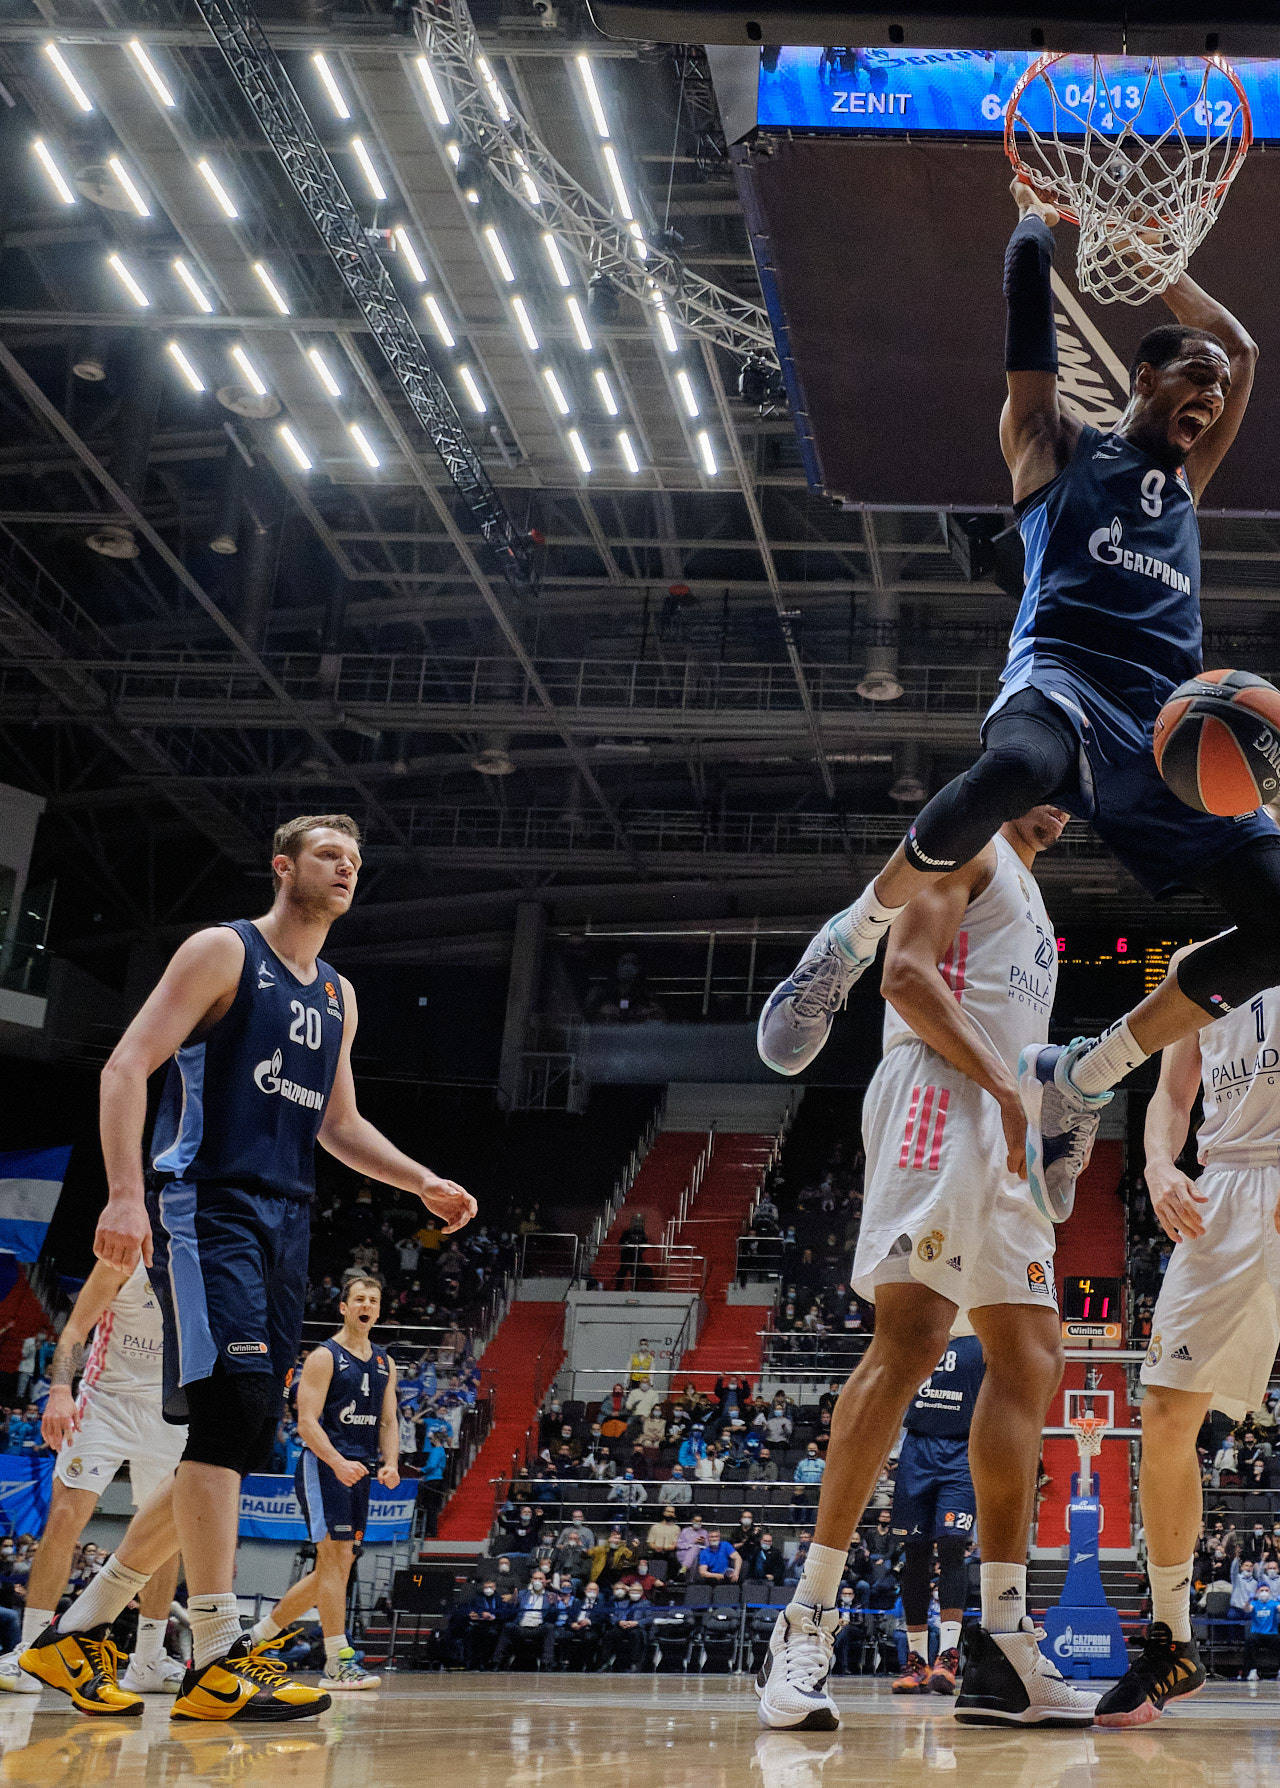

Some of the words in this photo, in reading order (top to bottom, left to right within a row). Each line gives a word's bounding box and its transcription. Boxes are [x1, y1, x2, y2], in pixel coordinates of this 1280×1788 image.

[830, 91, 913, 115] ZENIT
[1065, 84, 1140, 109] 04:13
[1194, 100, 1232, 127] 62
[1101, 112, 1114, 130] 4
[1141, 469, 1166, 518] 9
[1122, 550, 1191, 597] GAZPROM
[911, 839, 957, 867] BLINDSAVE
[1117, 938, 1128, 953] 6
[1008, 989, 1044, 1015] HOTEL
[289, 1000, 322, 1050] 20
[1251, 995, 1265, 1043] 1
[1083, 1296, 1109, 1318] 11
[1070, 1326, 1103, 1335] Winline
[231, 1344, 260, 1353] Winline
[1171, 1353, 1193, 1361] adidas
[360, 1372, 370, 1397] 4
[929, 1389, 963, 1401] GAZPROM
[241, 1498, 296, 1515] НАШЕ
[368, 1504, 408, 1517] НИТ
[955, 1512, 974, 1531] 28
[413, 1574, 423, 1587] 4
[1073, 1634, 1111, 1646] GAZPROM
